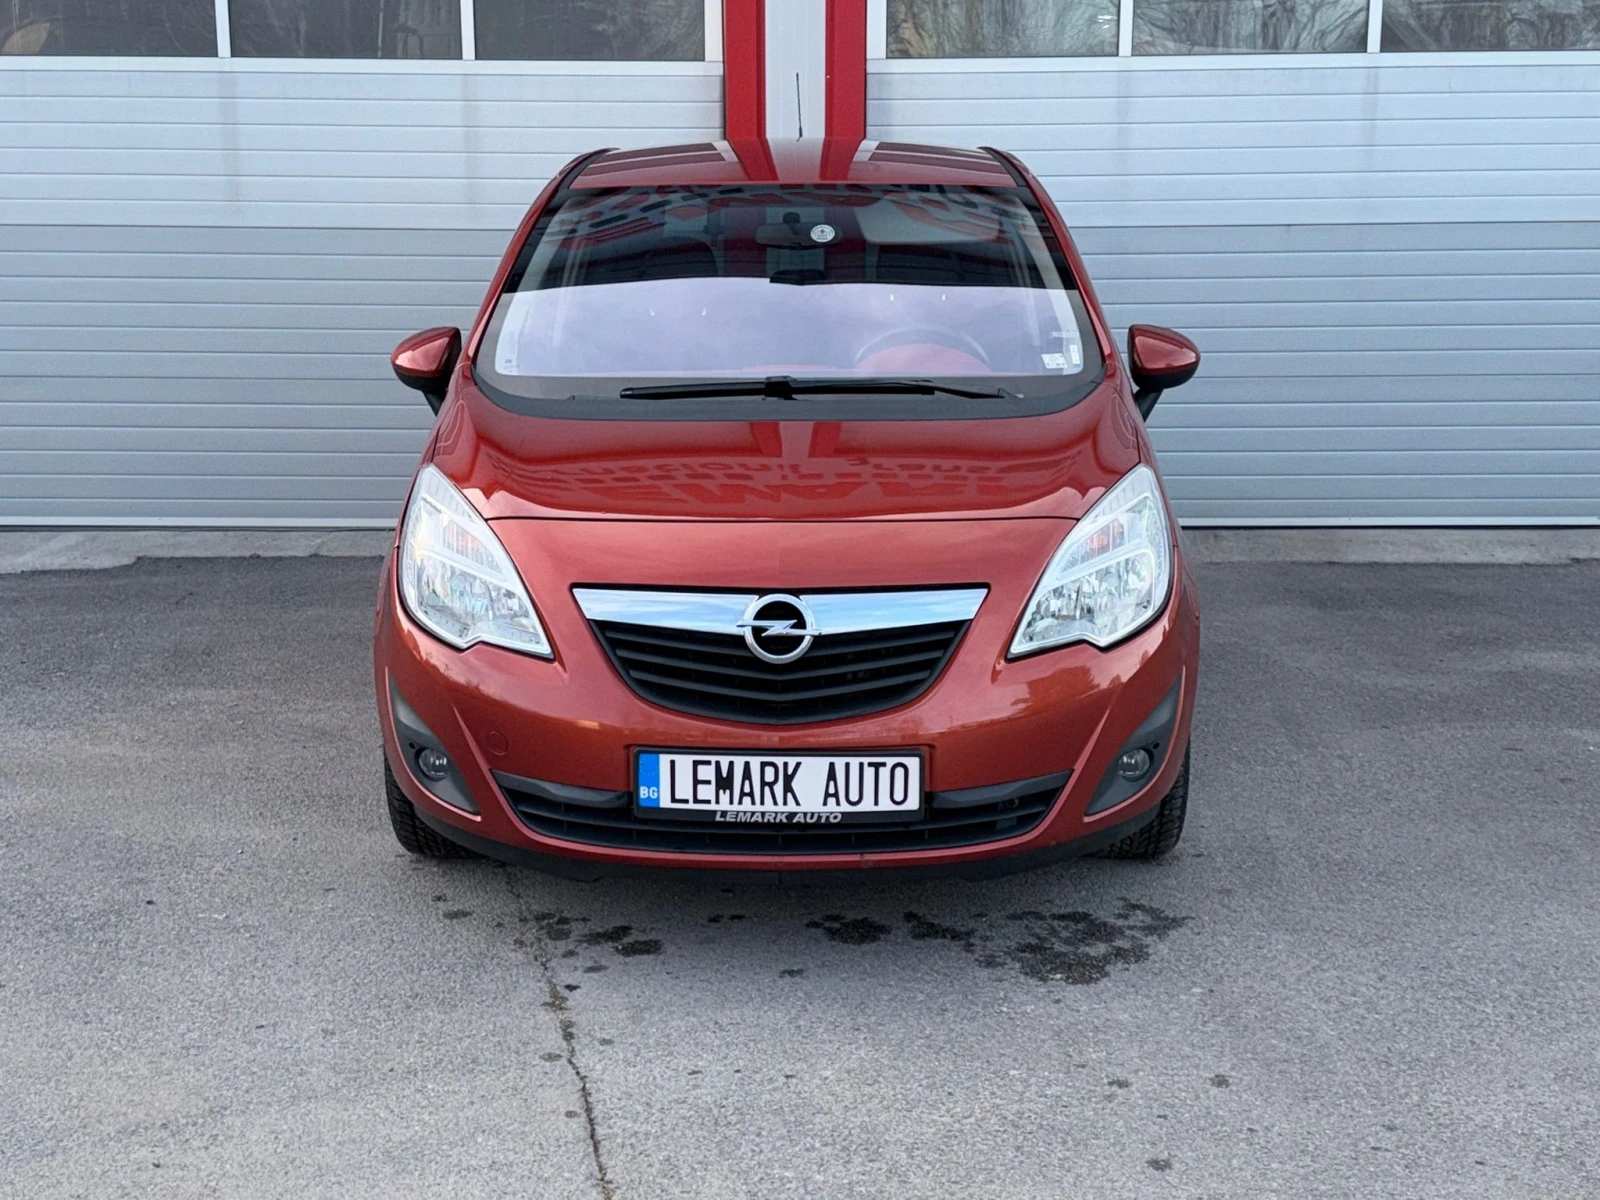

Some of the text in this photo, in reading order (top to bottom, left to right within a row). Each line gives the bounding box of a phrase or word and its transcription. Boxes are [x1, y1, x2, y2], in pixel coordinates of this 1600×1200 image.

[669, 759, 910, 807] LEMARK AUTO
[640, 785, 658, 799] BG
[715, 811, 842, 823] LEMARK AUTO
